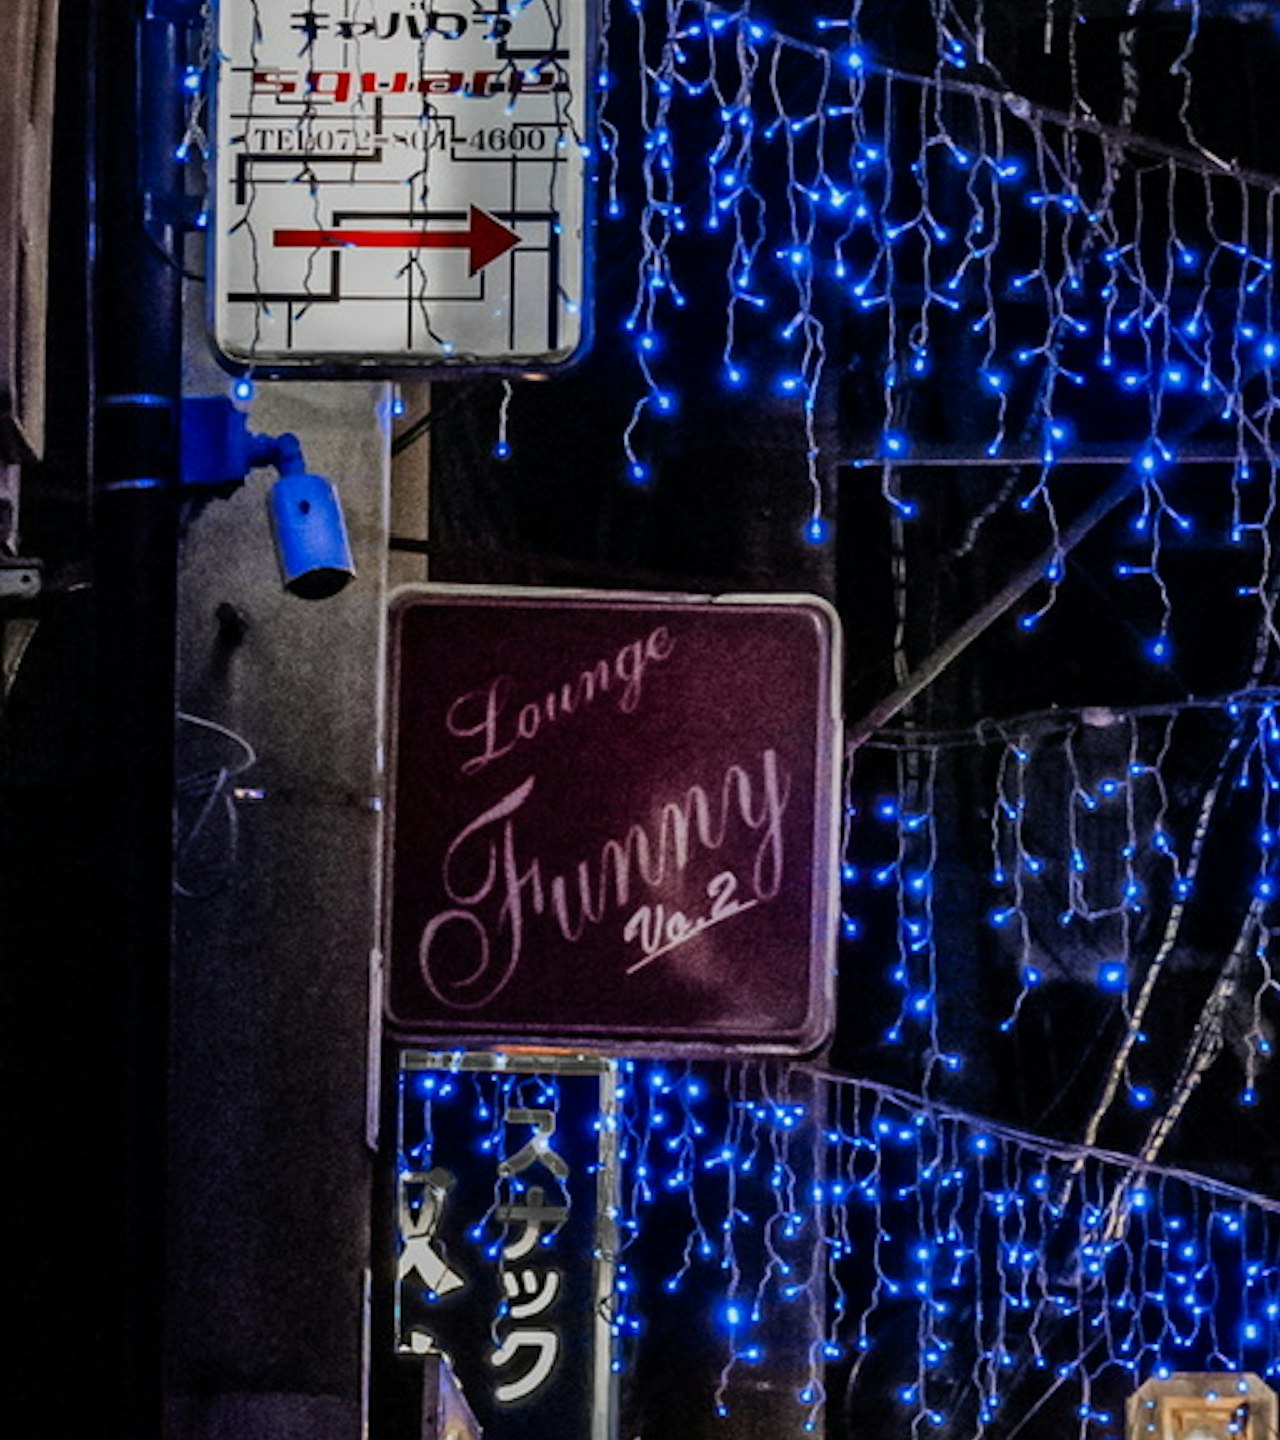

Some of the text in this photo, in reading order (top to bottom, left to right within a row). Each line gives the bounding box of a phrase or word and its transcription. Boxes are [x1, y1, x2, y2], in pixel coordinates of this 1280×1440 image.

[250, 69, 570, 103] square
[443, 622, 678, 777] Lounge
[417, 748, 793, 1010] Funny
[491, 1107, 572, 1405] スナック
